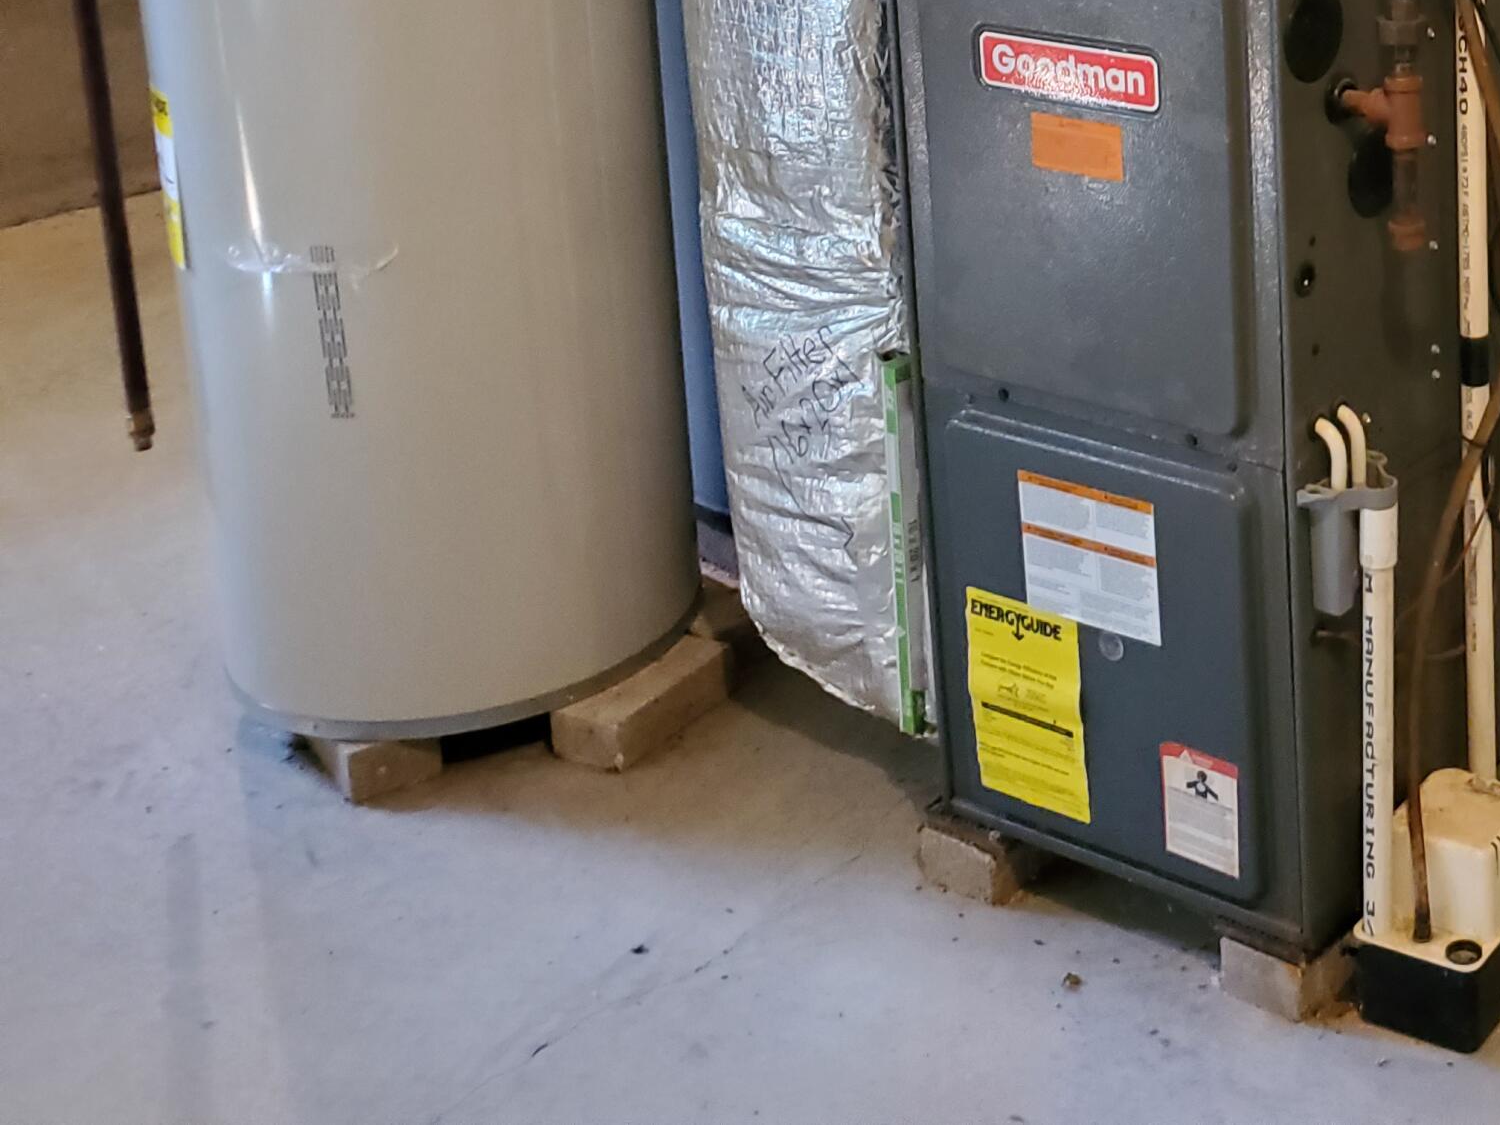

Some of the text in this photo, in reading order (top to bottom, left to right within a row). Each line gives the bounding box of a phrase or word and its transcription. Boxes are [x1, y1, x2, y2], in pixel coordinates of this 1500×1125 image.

[991, 43, 1146, 96] Goodman
[762, 324, 835, 396] Filter
[970, 598, 1063, 642] ENERGYGUIDE
[1365, 615, 1376, 880] MANUFACTURING
